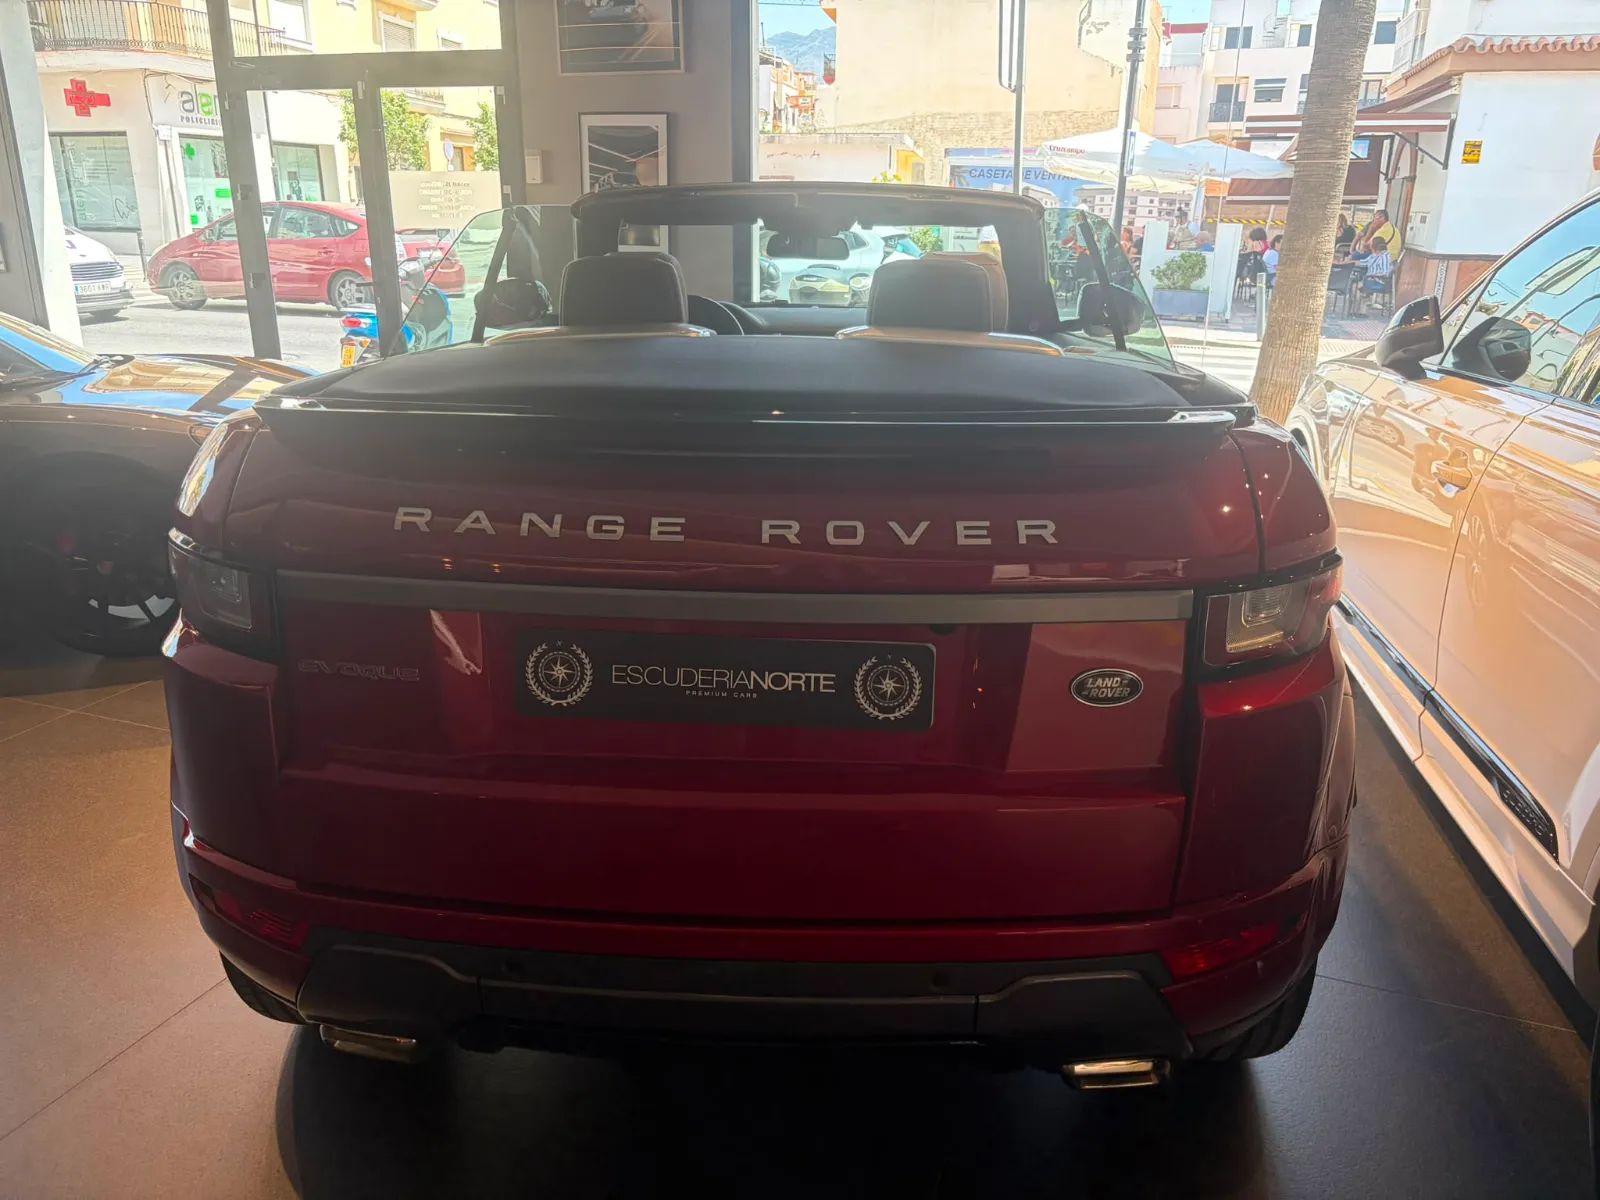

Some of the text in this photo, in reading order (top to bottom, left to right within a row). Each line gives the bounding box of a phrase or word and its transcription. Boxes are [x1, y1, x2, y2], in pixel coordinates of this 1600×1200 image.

[180, 115, 221, 126] POLICLINI
[968, 168, 1013, 179] CASETA
[394, 506, 1058, 546] RANGE ROVER
[298, 659, 420, 681] EVOQUE
[612, 664, 837, 693] ESCUDERIANORTE
[1086, 677, 1121, 688] LAND
[685, 689, 758, 699] PREMIUM CARS
[1088, 687, 1131, 698] ROVER
